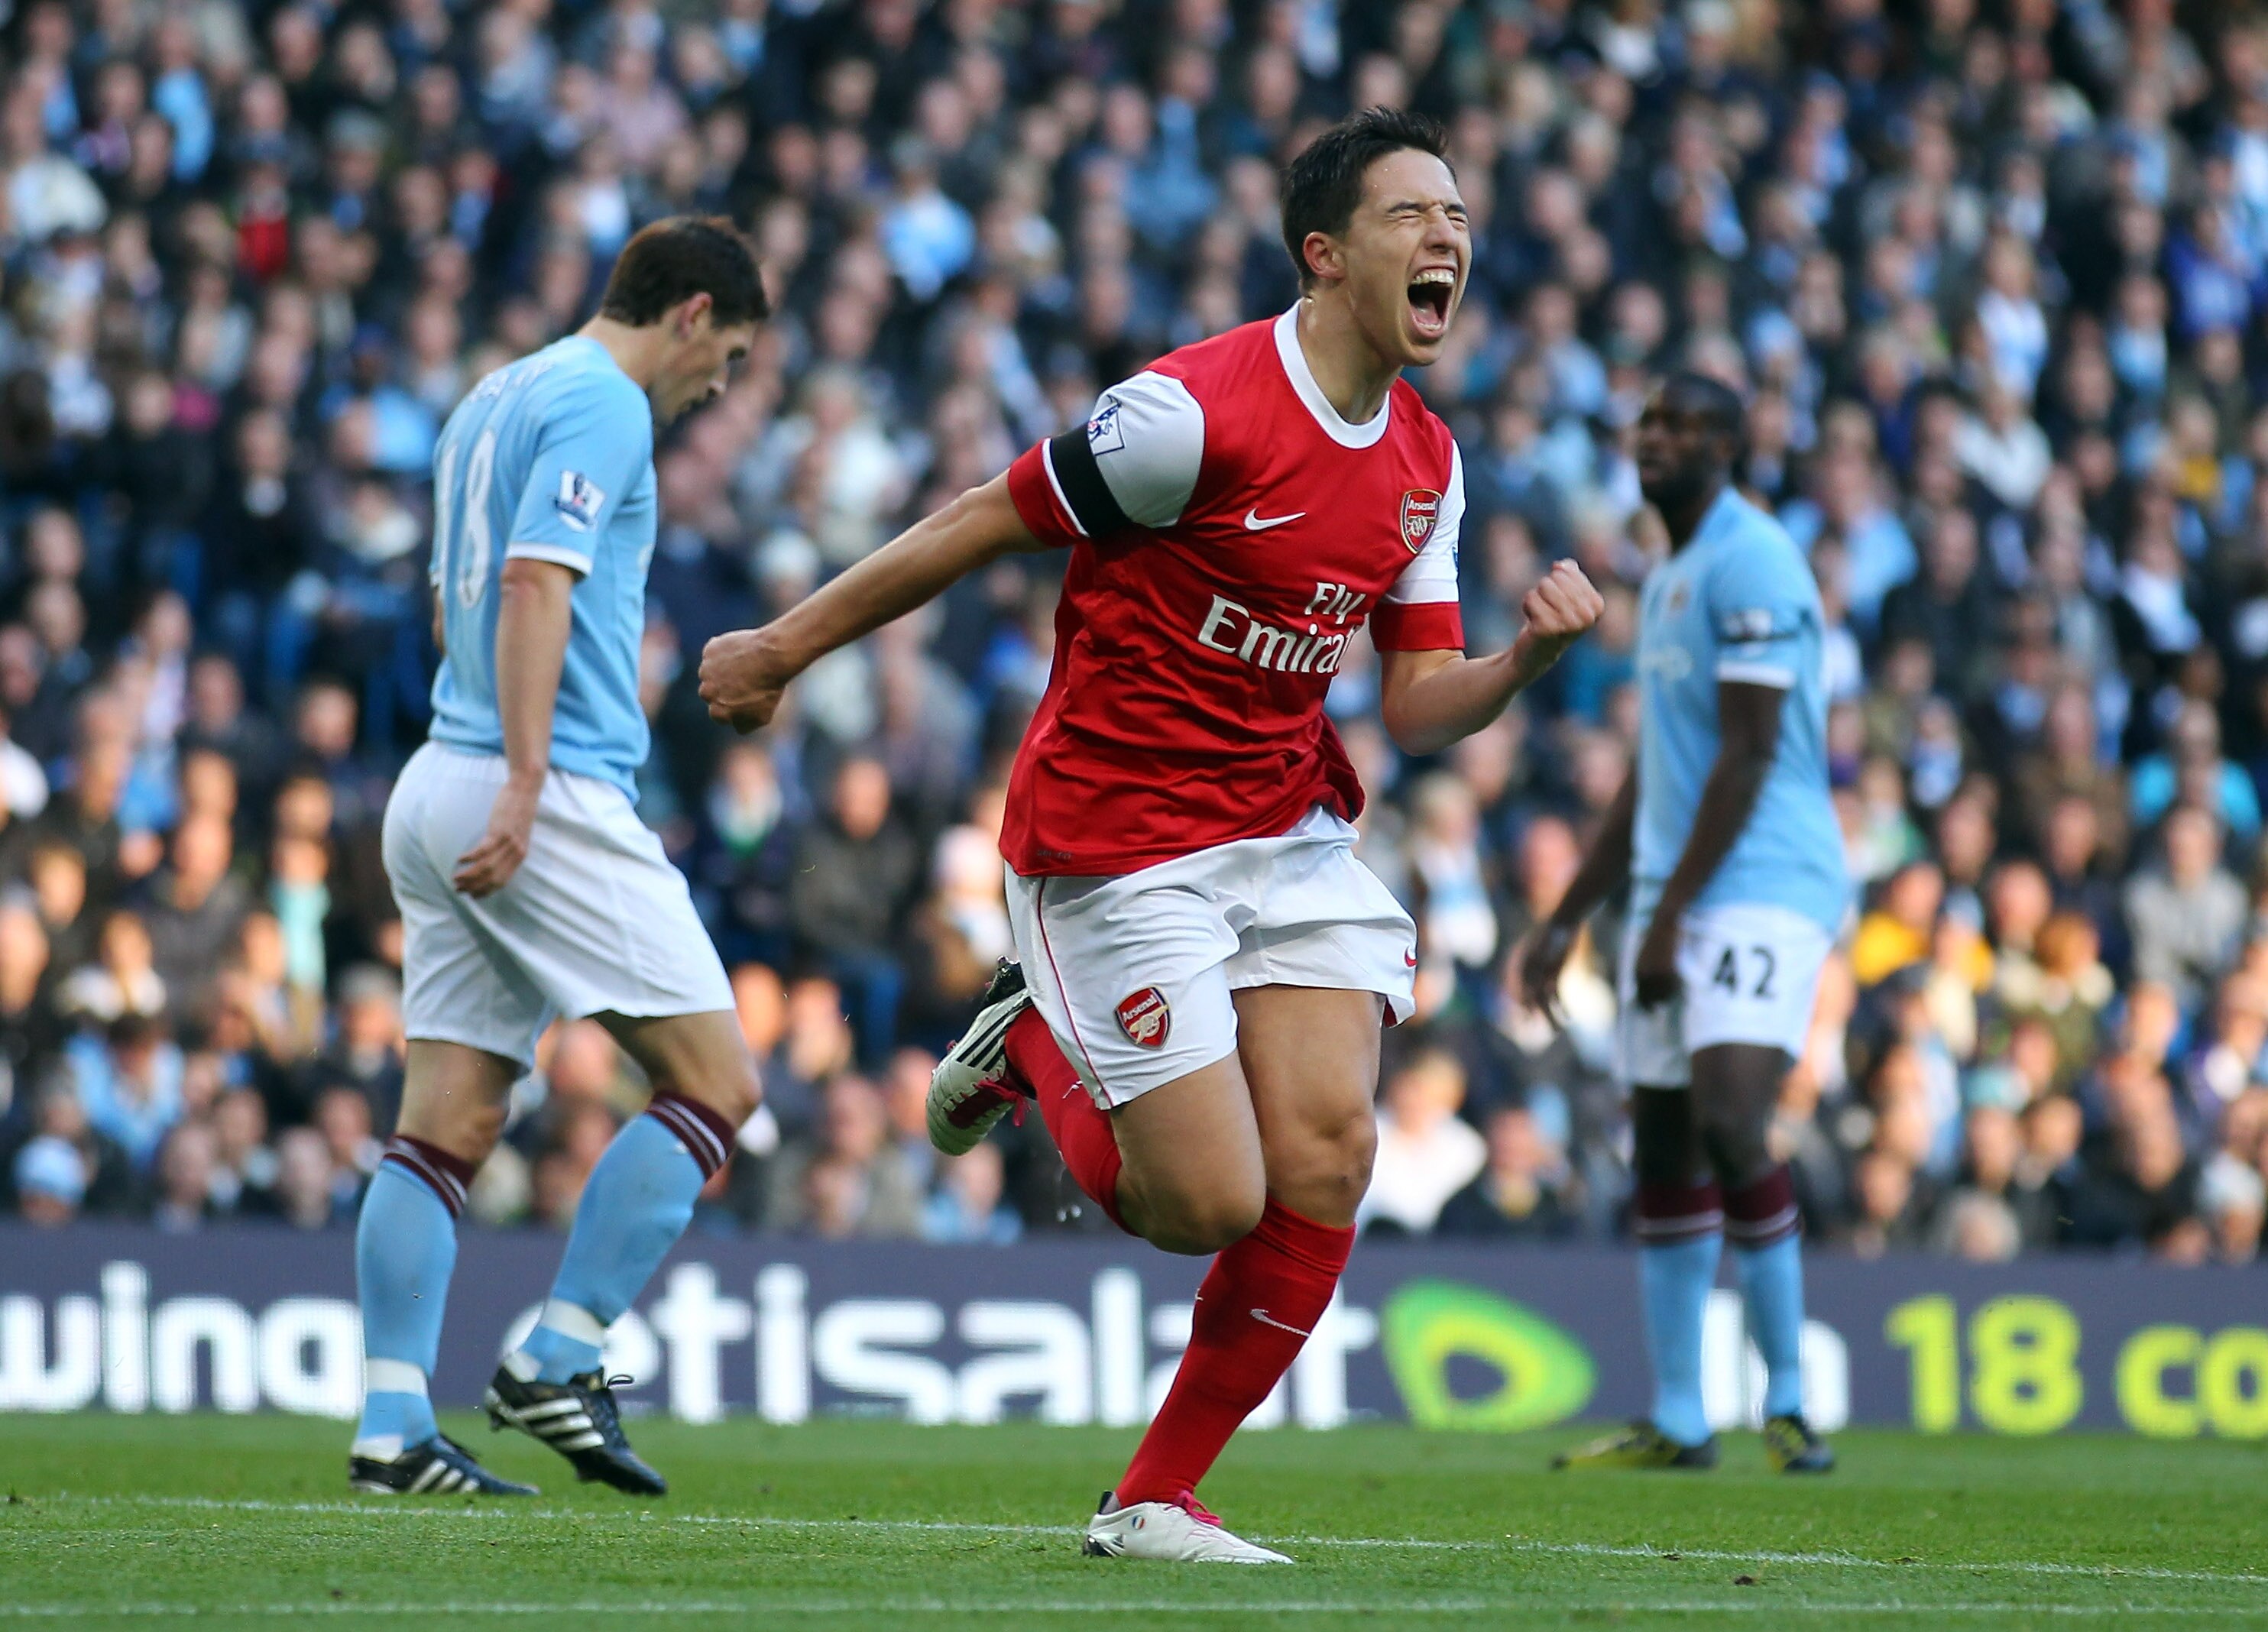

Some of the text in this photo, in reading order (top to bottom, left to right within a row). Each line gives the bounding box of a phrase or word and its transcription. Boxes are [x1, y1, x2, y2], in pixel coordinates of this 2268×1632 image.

[1304, 581, 1366, 624] Fly
[1712, 944, 1777, 999] 42
[1123, 994, 1158, 1023] Arsenal
[1885, 1293, 2084, 1437] 18
[2114, 1323, 2268, 1439] co
